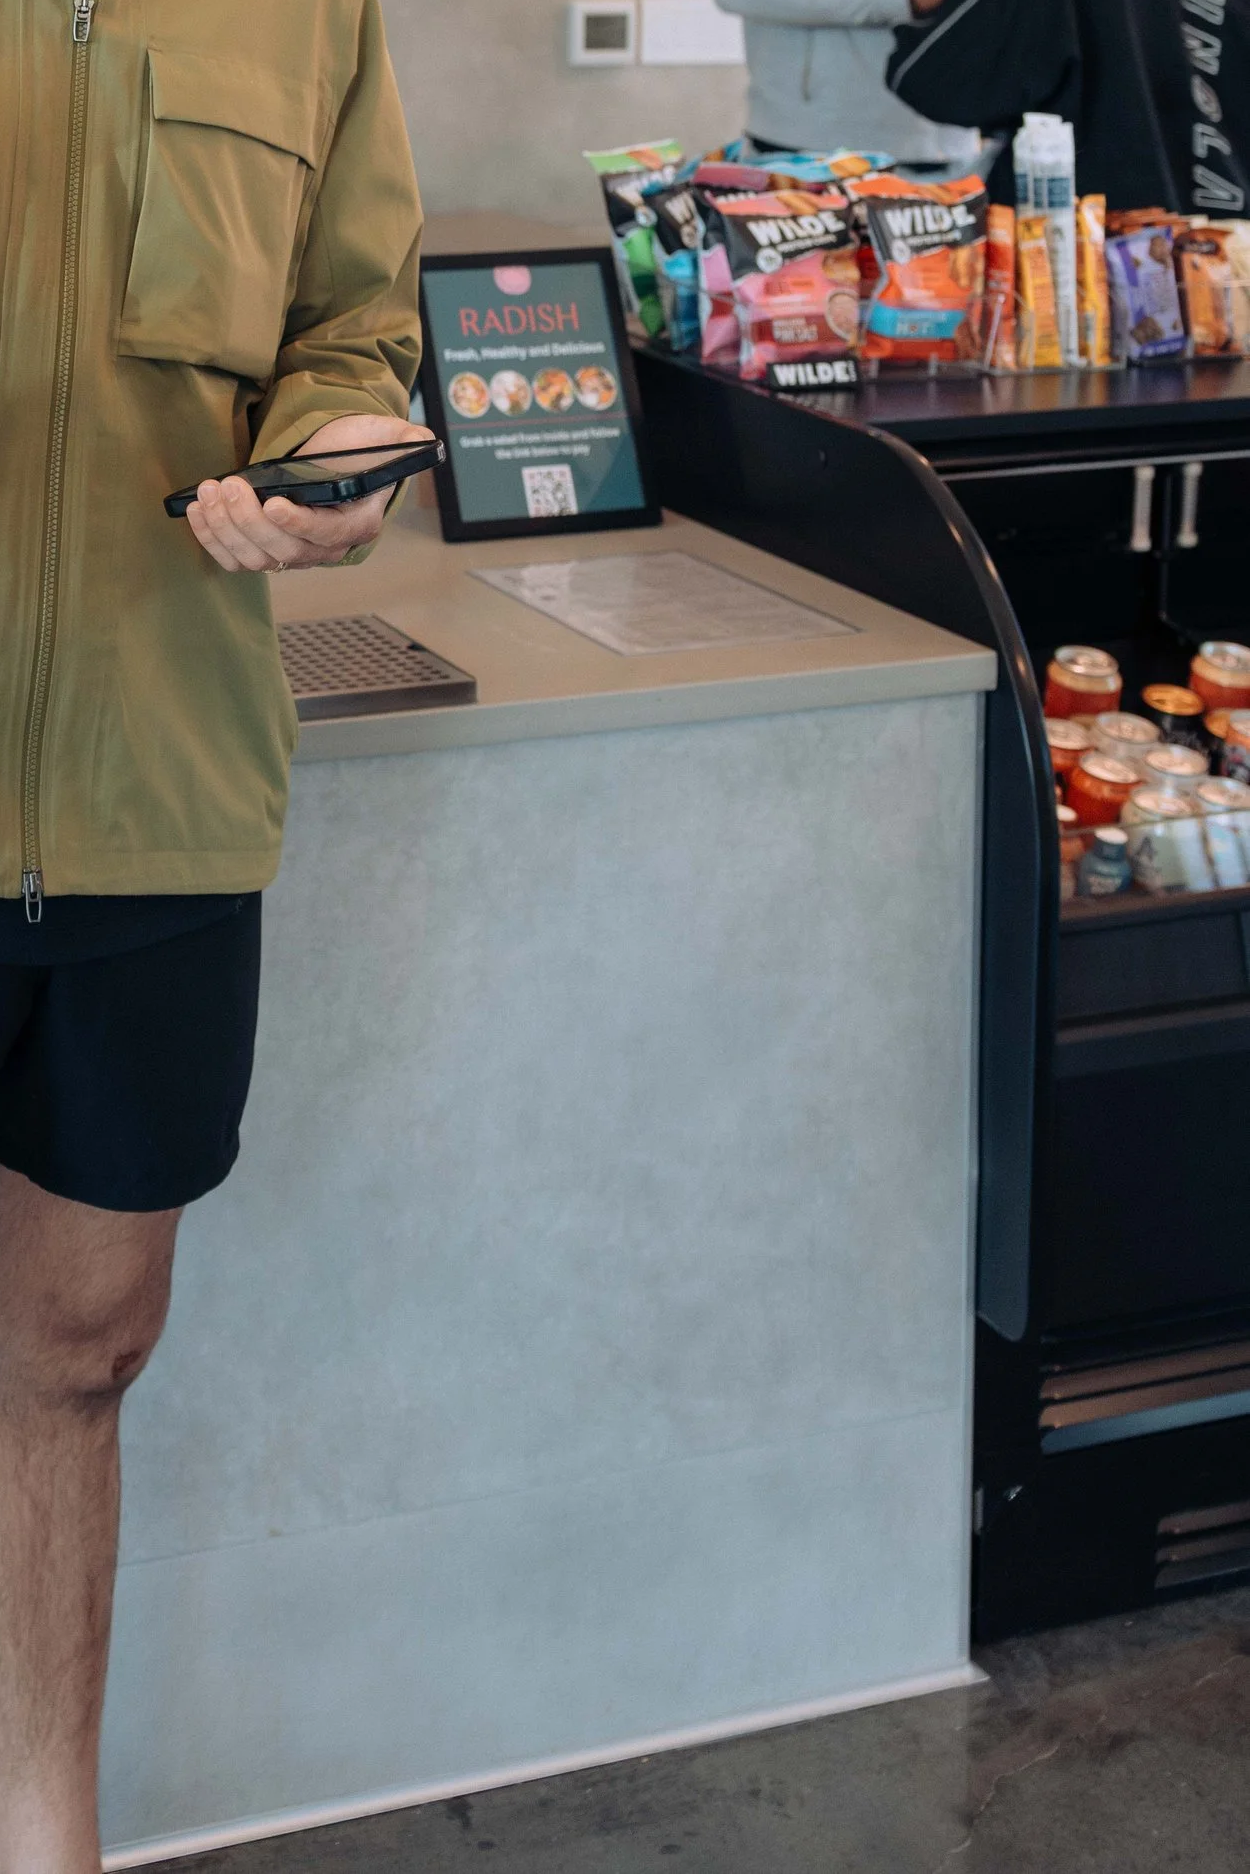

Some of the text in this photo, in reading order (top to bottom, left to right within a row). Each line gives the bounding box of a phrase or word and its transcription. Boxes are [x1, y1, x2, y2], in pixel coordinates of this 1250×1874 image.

[746, 210, 847, 247] WILDE
[883, 203, 977, 238] WILDE
[459, 301, 580, 338] RADISH
[528, 342, 550, 358] and
[773, 360, 850, 387] WILDE
